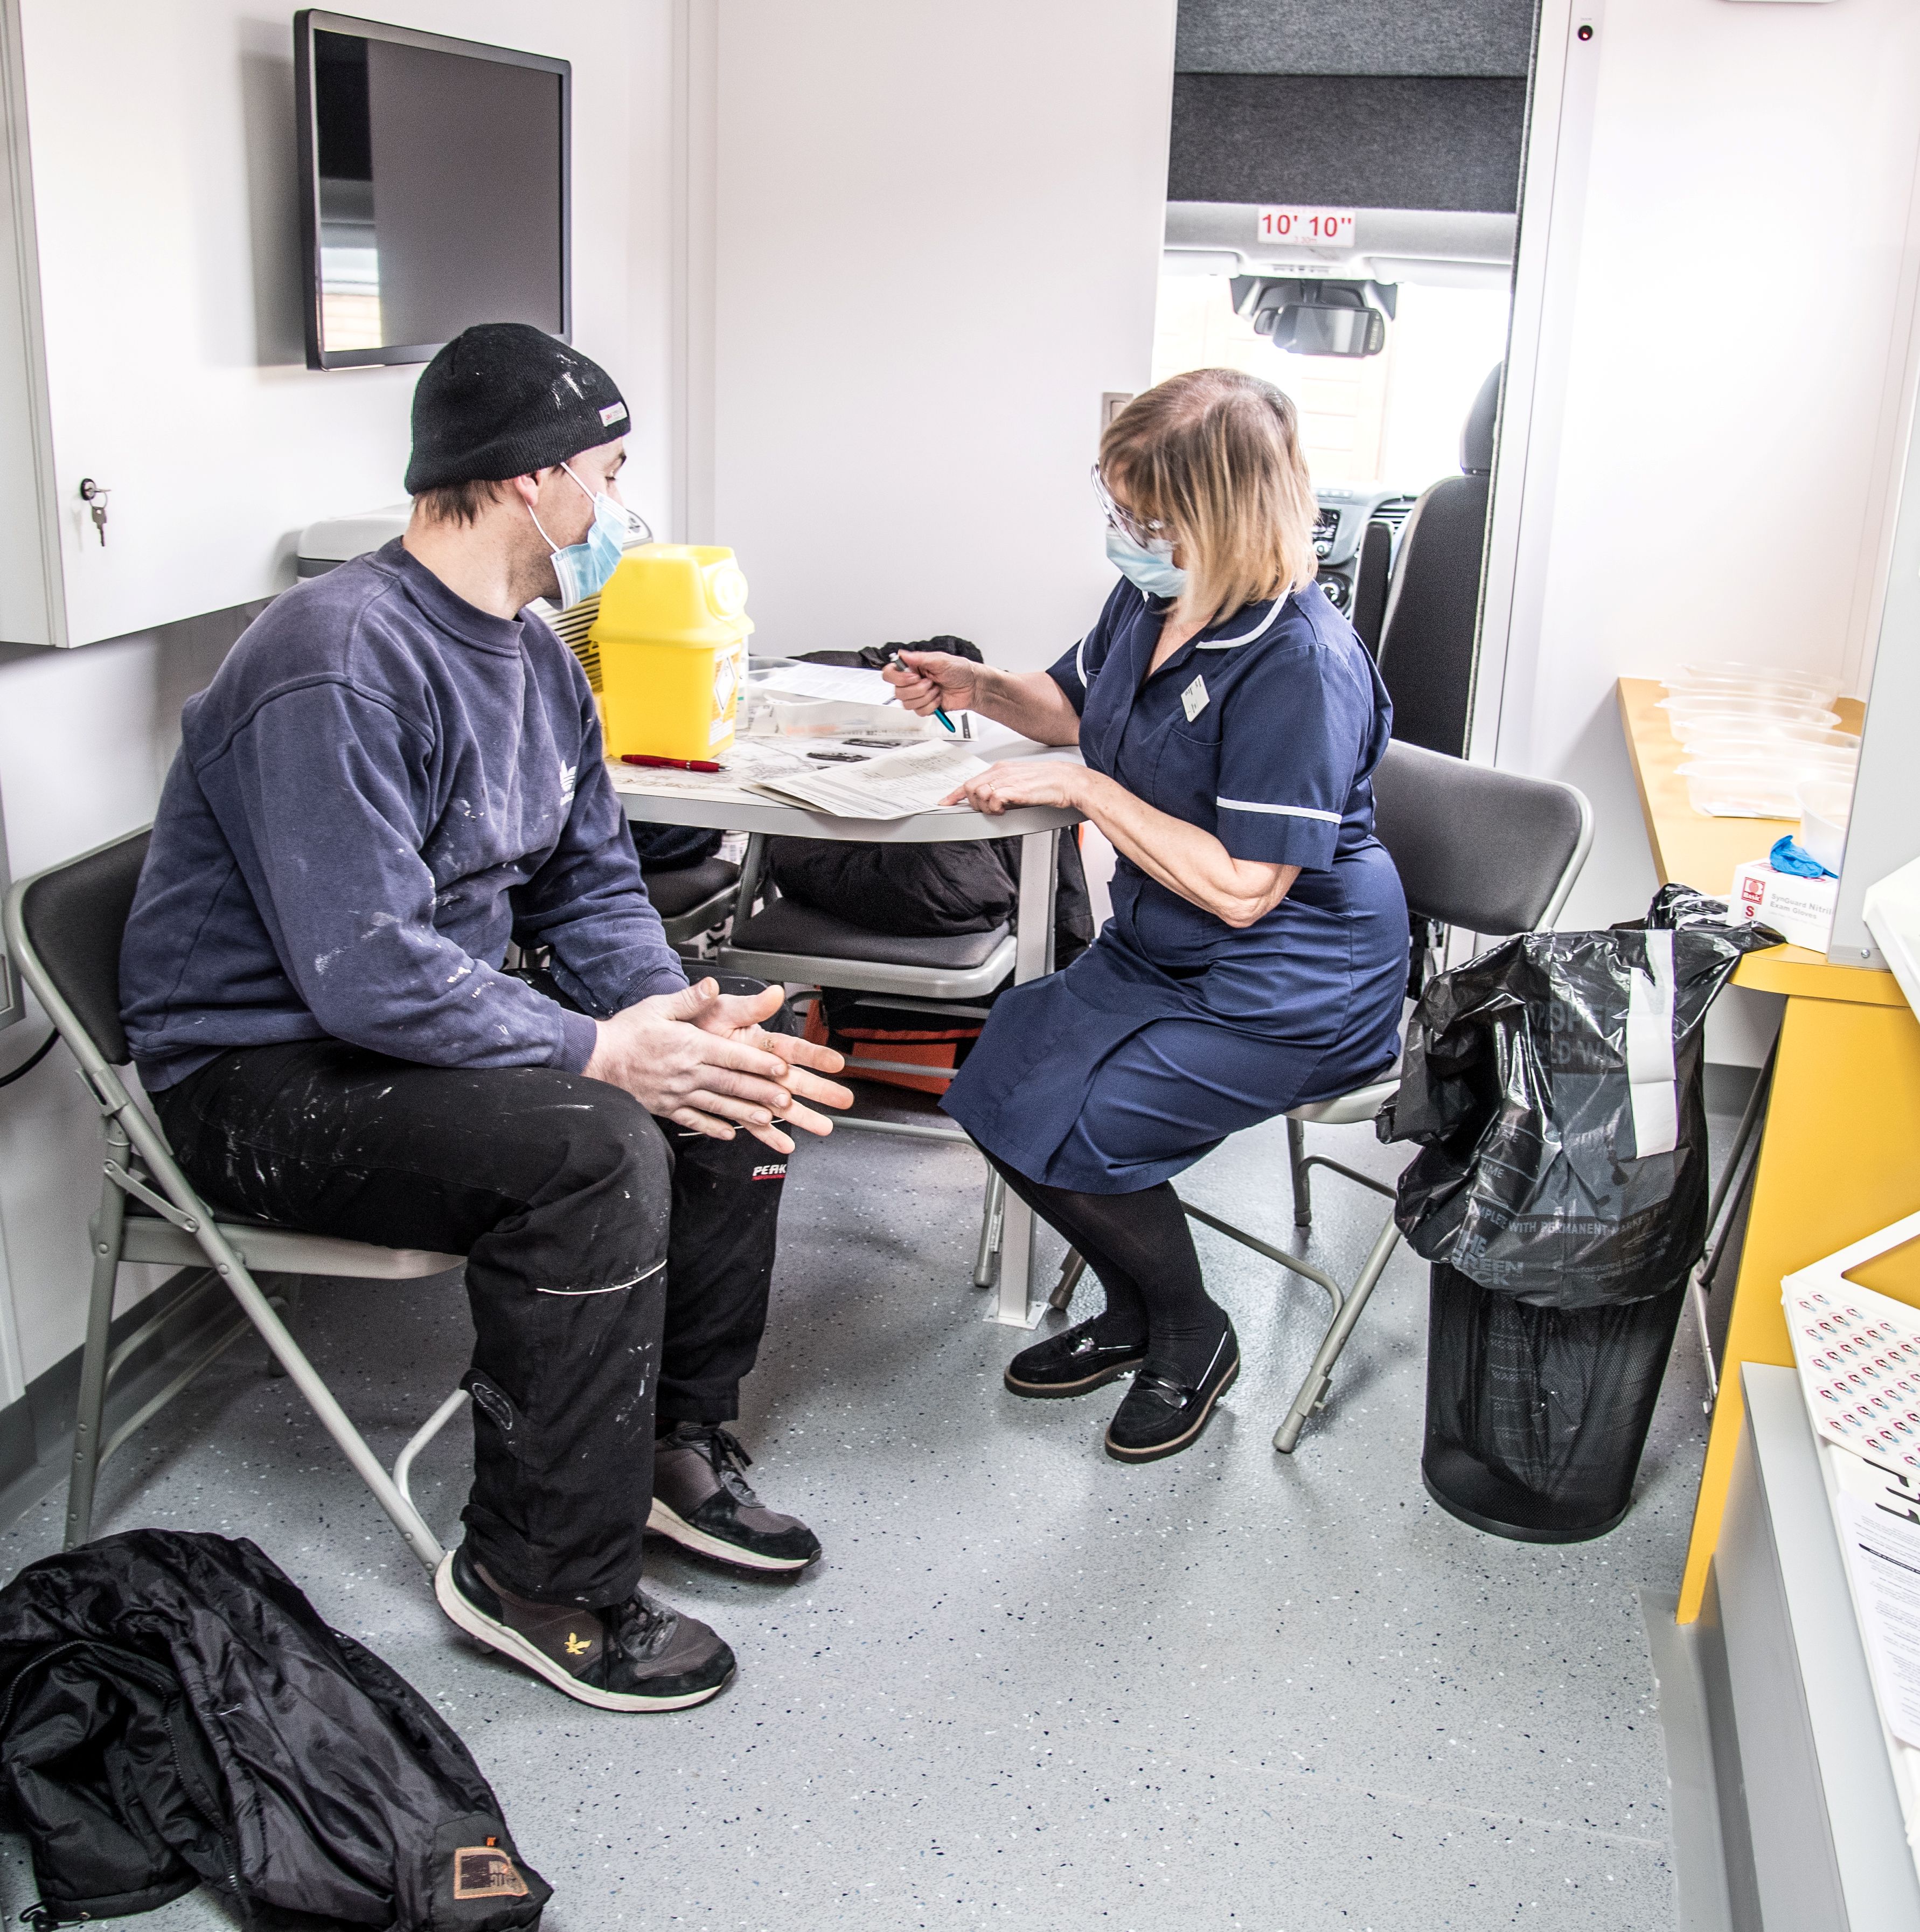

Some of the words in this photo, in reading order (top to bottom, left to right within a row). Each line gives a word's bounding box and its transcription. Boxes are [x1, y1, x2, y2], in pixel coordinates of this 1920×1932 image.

[1262, 214, 1298, 235] 10'
[1745, 905, 1755, 918] S
[1770, 901, 1790, 912] Exam
[1792, 908, 1817, 920] Gloves
[1771, 893, 1807, 908] SynGuard
[1808, 903, 1833, 915] Nitril
[752, 1164, 788, 1177] PEAK
[1480, 1161, 1505, 1179] TIME
[1508, 1220, 1538, 1234] WITH
[1540, 1218, 1608, 1235] PERMANENT
